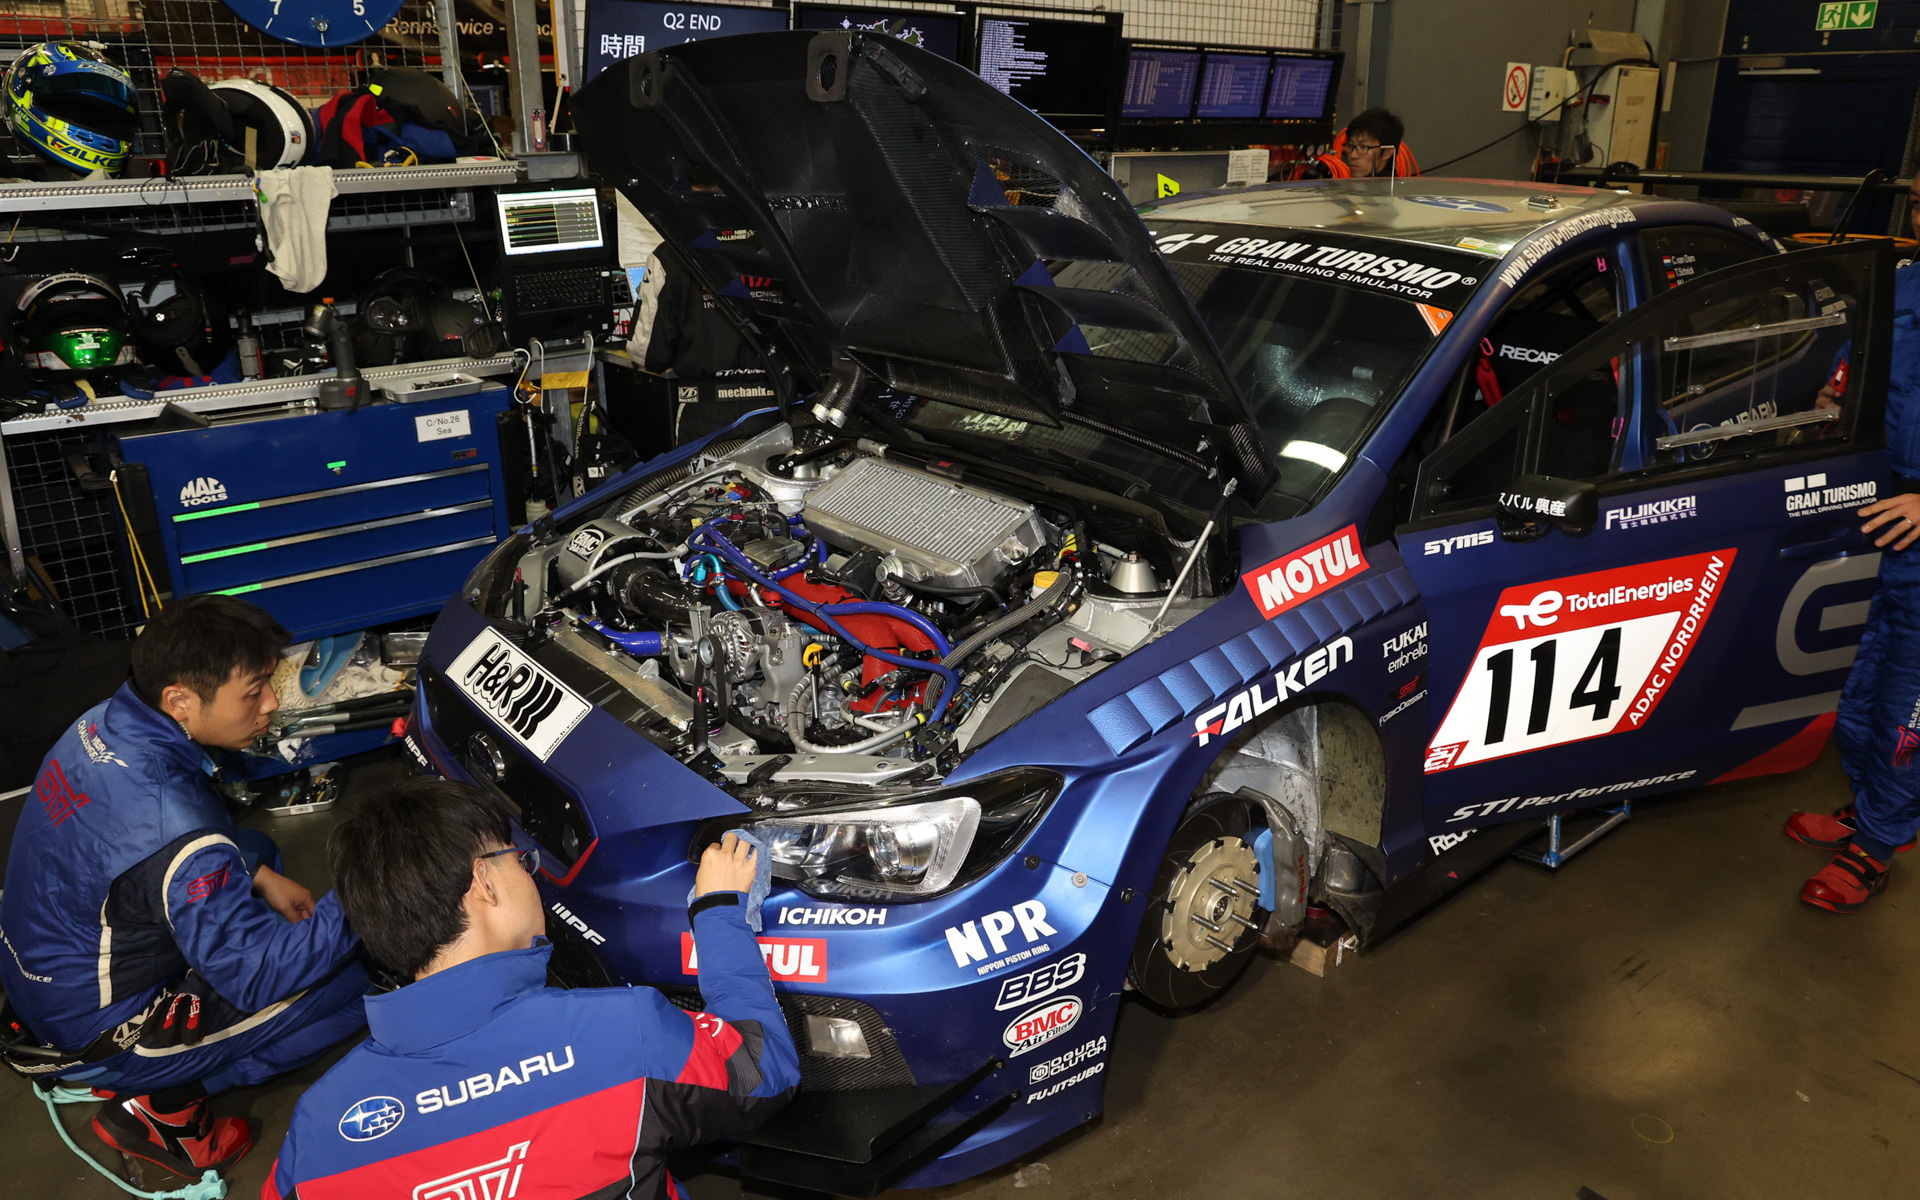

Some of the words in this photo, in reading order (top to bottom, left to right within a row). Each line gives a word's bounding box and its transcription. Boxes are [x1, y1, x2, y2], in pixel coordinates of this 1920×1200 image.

[663, 12, 685, 30] Q2
[689, 14, 721, 31] END
[600, 33, 645, 59] 時間
[1207, 253, 1233, 263] THE
[1235, 255, 1270, 268] REAL
[1273, 258, 1336, 278] DRIVING
[1336, 272, 1434, 299] SIMULATOR
[1214, 237, 1312, 261] GRAN
[1301, 246, 1462, 290] TURISMO
[1499, 344, 1562, 365] RECAR
[180, 477, 226, 500] MAC
[180, 493, 228, 507] TOOLS
[1499, 492, 1566, 516] スバル興産
[1786, 491, 1820, 511] GRAN
[1822, 481, 1876, 504] TURISMO
[1843, 497, 1877, 508] SIMULATOR
[1605, 496, 1696, 530] FUJIKIKAI
[1257, 535, 1360, 611] MOTUL
[1566, 577, 1694, 612] TotalEnergies
[1383, 621, 1427, 658] FUKAI
[1628, 674, 1666, 725] ADAC
[1665, 555, 1725, 674] NORDRHEIN
[1388, 641, 1427, 673] embrella
[1191, 636, 1353, 748] FALKEN
[1484, 627, 1622, 745] 114
[77, 720, 98, 760] CHALLENGE
[1446, 797, 1520, 823] STI
[778, 907, 887, 925] ICHIKOH
[944, 900, 1058, 968] NPR
[977, 959, 1005, 976] NIPPON
[1005, 949, 1032, 966] PISTON
[1032, 944, 1050, 956] RING
[995, 953, 1086, 1010] BBS
[1015, 1003, 1073, 1042] BMC
[1017, 1034, 1045, 1052] Air
[1046, 1023, 1068, 1039] Filter
[1050, 1042, 1107, 1076] CLUTCH
[1051, 1035, 1107, 1067] OGURA
[415, 1045, 576, 1115] SUBARU
[1027, 1062, 1104, 1104] FUJITSUBO
